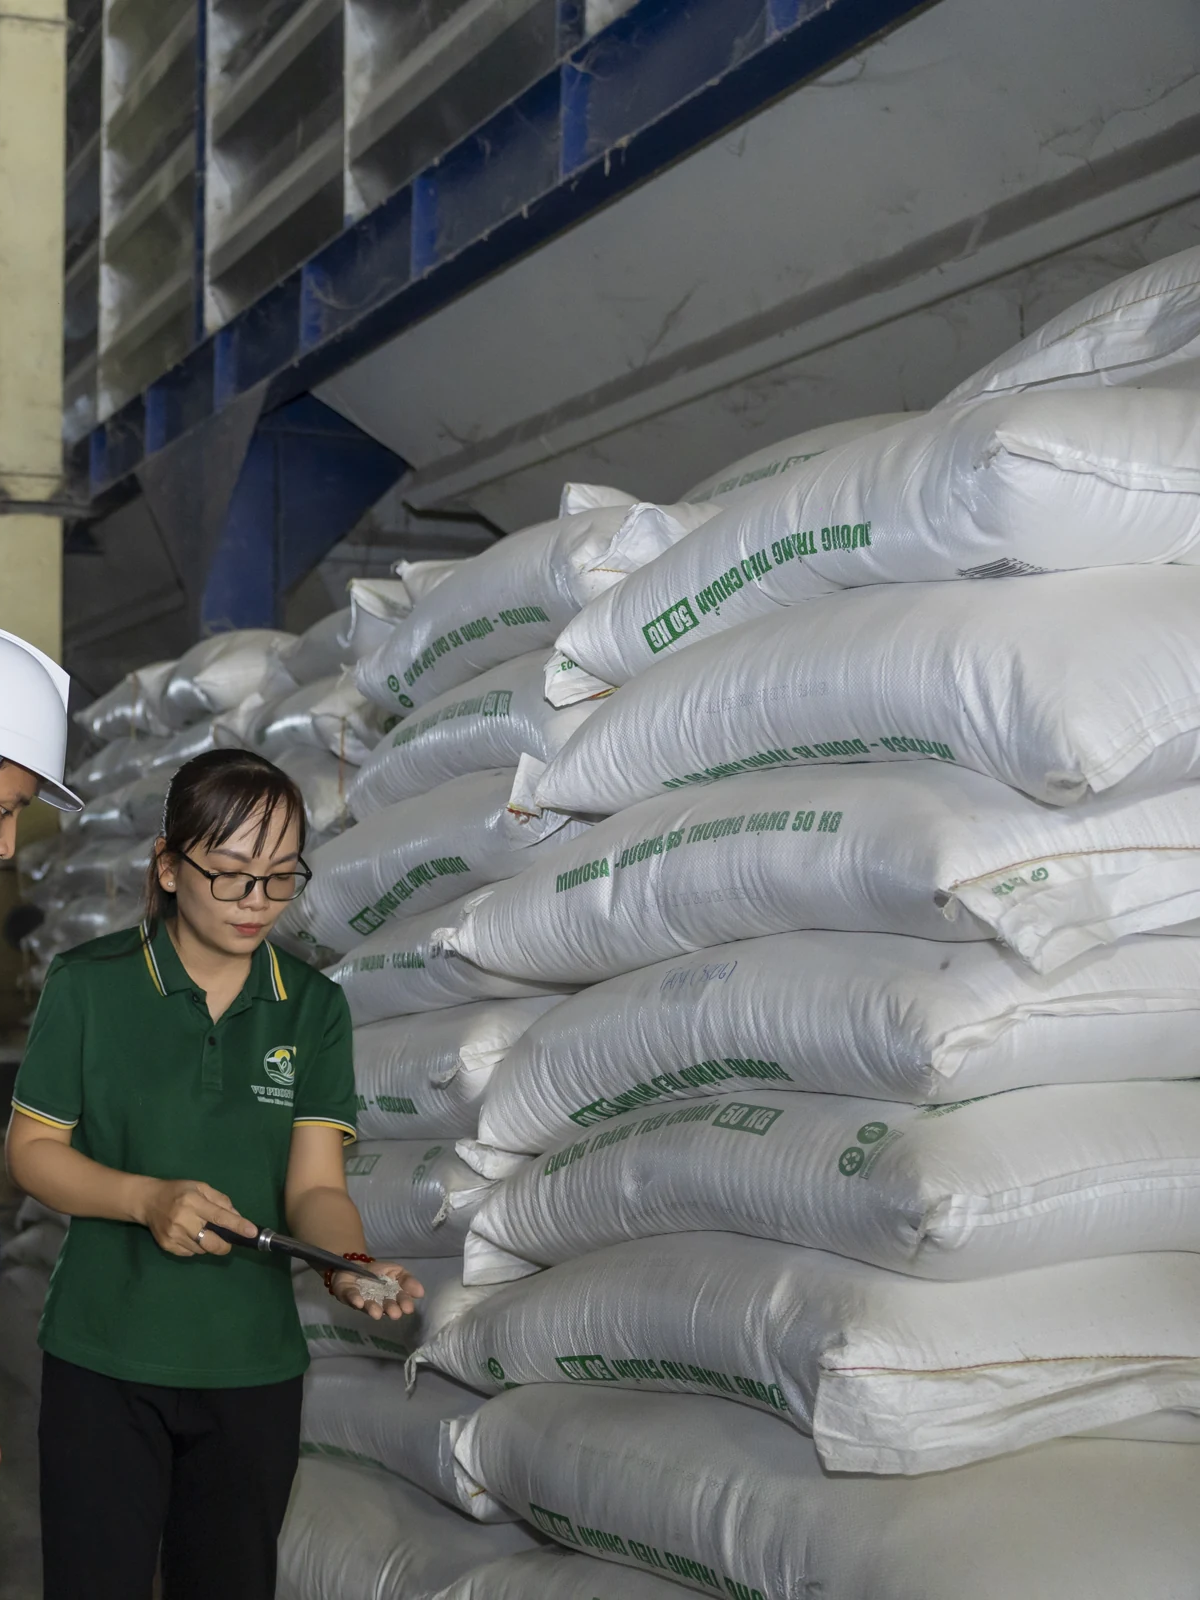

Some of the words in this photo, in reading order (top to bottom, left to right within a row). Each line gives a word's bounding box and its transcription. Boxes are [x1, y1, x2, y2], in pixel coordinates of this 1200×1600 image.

[695, 567, 745, 616] CHUẨN
[499, 607, 550, 627] MIMOSA
[669, 604, 693, 633] 50
[648, 618, 673, 649] KG
[556, 858, 610, 893] MIMOSA
[745, 811, 790, 836] HẠNG
[792, 810, 816, 832] 50
[817, 811, 844, 833] KG
[720, 1106, 747, 1125] 50
[746, 1108, 777, 1131] KG
[577, 1525, 630, 1557] CHUẨN
[628, 1540, 668, 1570] TIÊU
